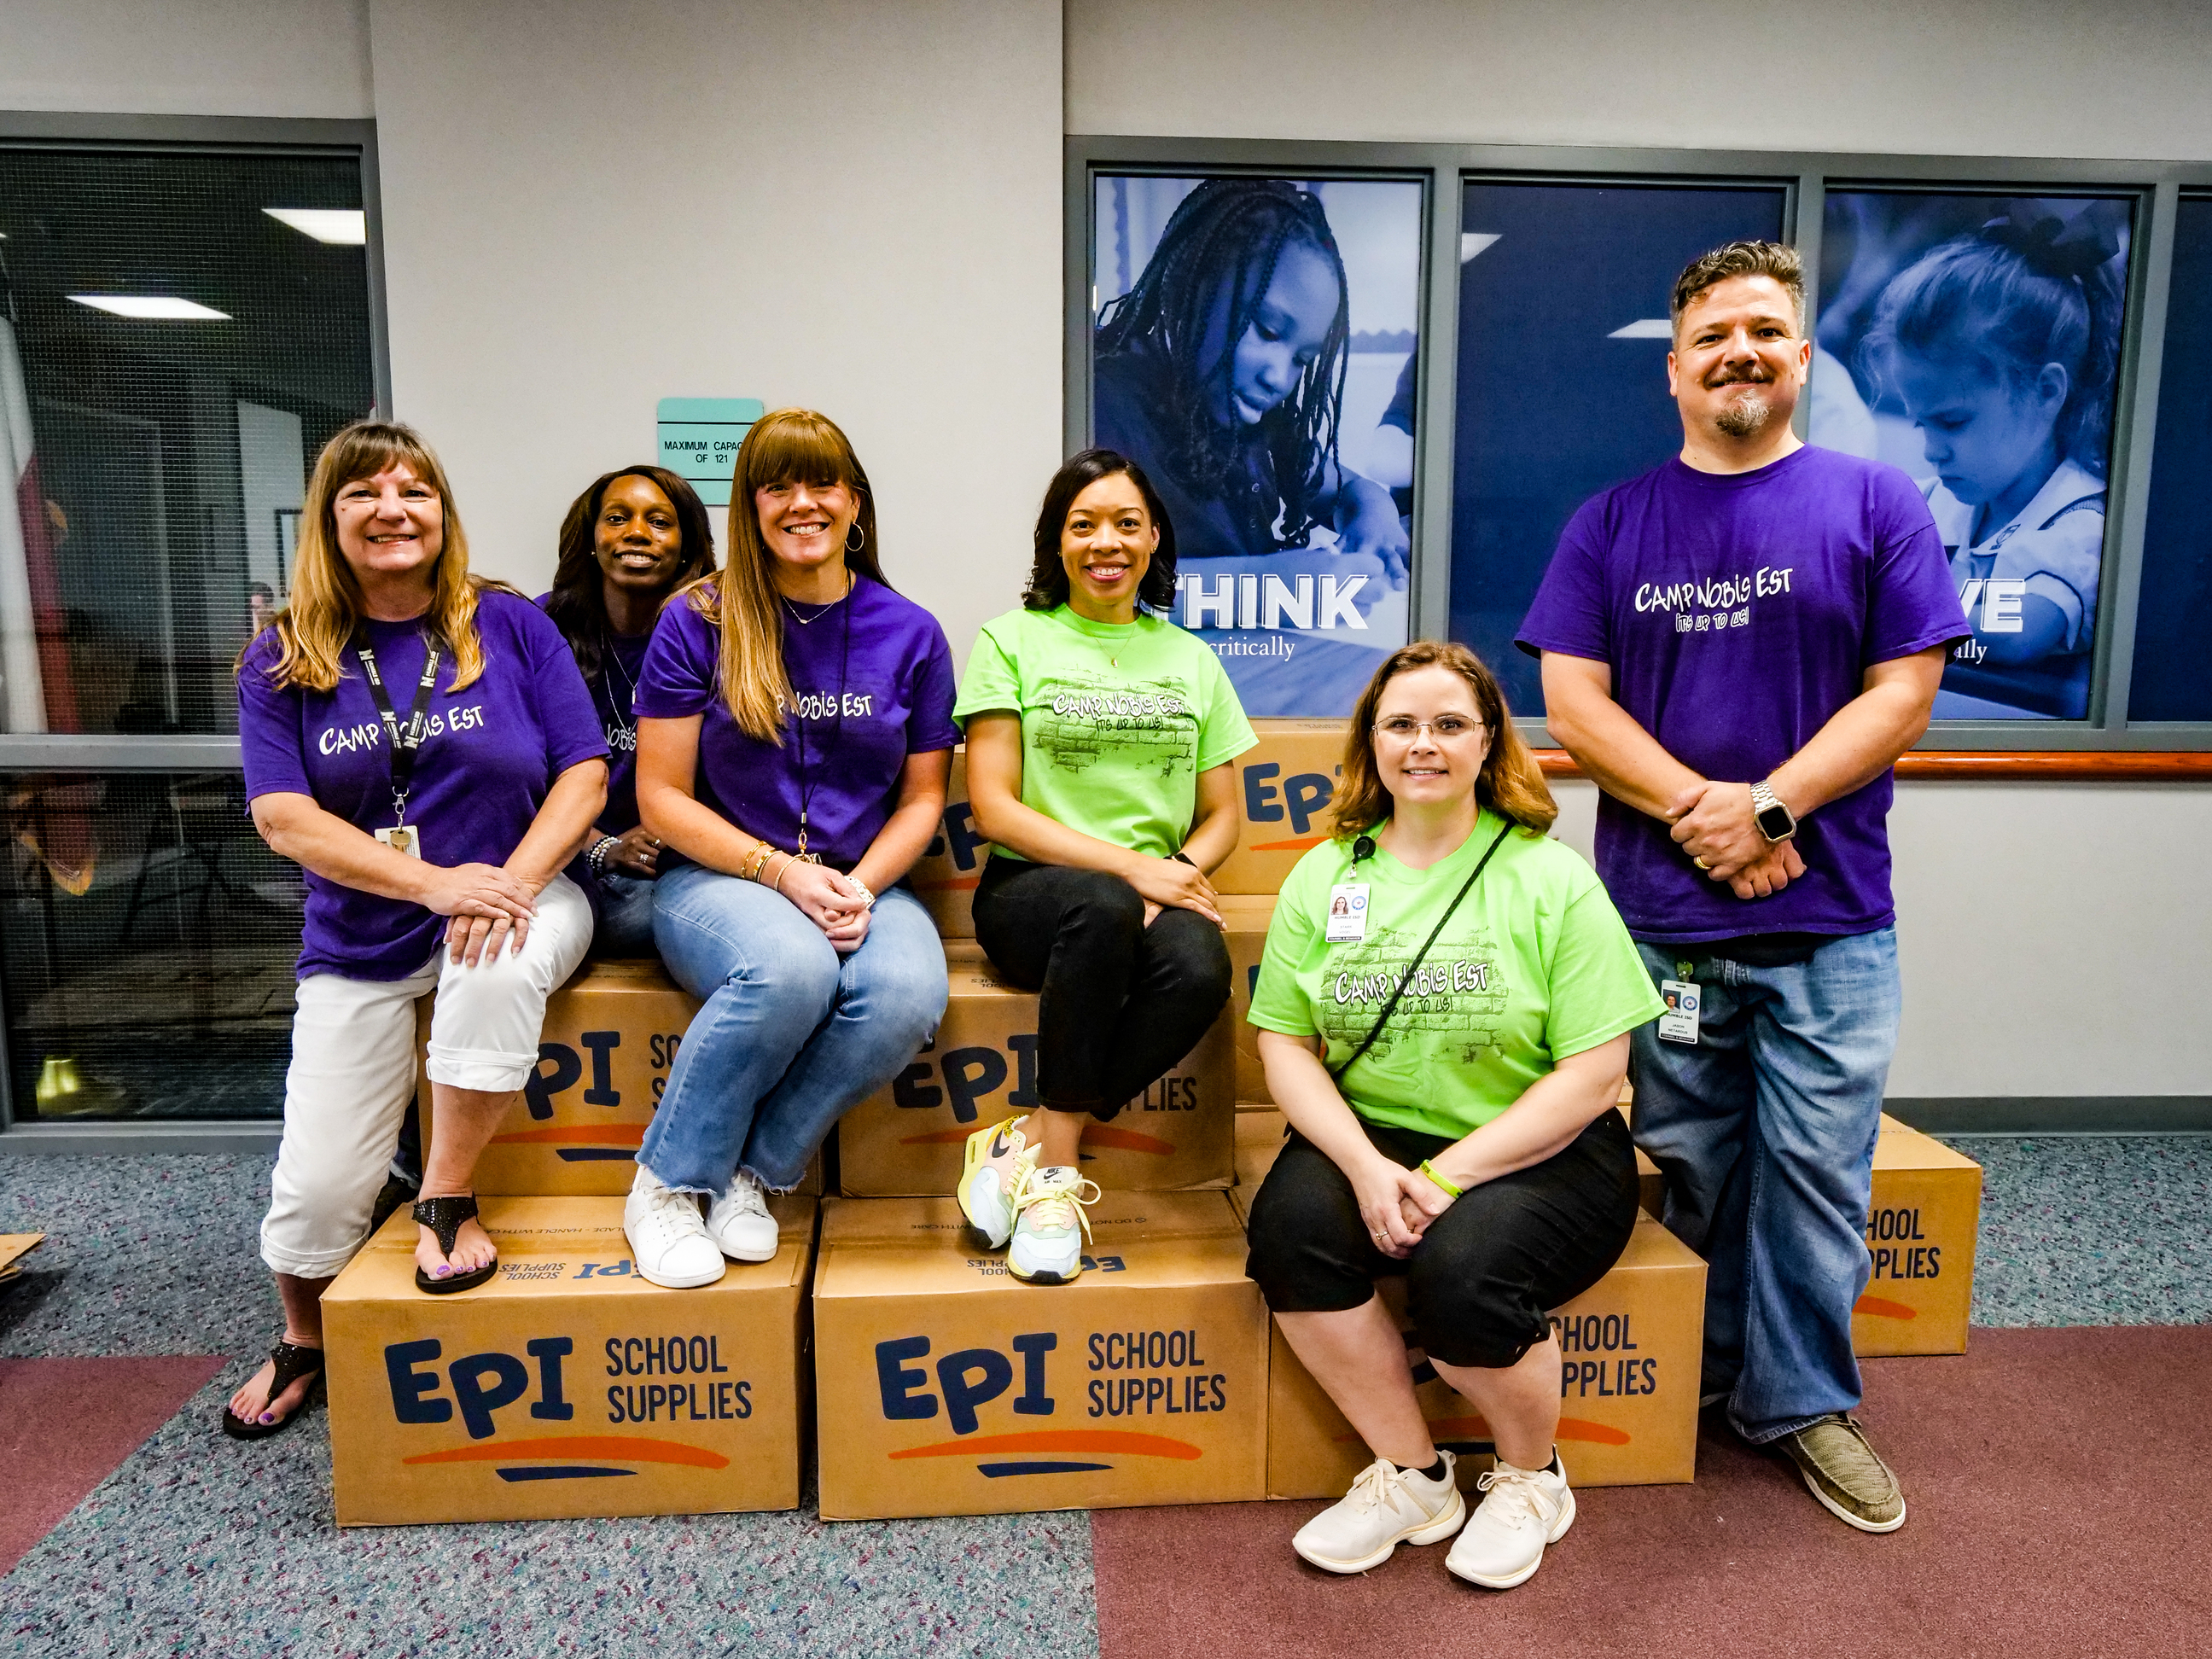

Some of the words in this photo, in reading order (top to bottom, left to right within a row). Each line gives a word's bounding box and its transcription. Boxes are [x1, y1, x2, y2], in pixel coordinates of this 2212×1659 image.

[664, 441, 707, 450] MAXIMUM
[713, 441, 743, 451] CAPAC
[695, 454, 708, 463] OF
[715, 454, 728, 463] 121
[1635, 582, 1694, 612] CAMP
[1695, 613, 1711, 631] UP
[1713, 612, 1728, 630] TO
[1730, 606, 1749, 628] US!
[1052, 693, 1103, 719] CAMP
[319, 723, 379, 756] CAMP
[1117, 719, 1129, 731] UP
[1133, 718, 1144, 729] TO
[1243, 763, 1345, 835] EP
[1334, 972, 1388, 1006] CAMP
[1403, 1001, 1414, 1016] UP
[1417, 999, 1431, 1013] TO
[1866, 1209, 1924, 1240] HOOL
[498, 1263, 567, 1272] SUPPLIES
[506, 1272, 561, 1280] SCHOOL
[605, 1335, 728, 1377] SCHOOL
[1088, 1330, 1205, 1372] SCHOOL
[1561, 1357, 1657, 1398] PPLIES
[607, 1381, 753, 1423] SUPPLIES
[1088, 1374, 1227, 1418] SUPPLIES
